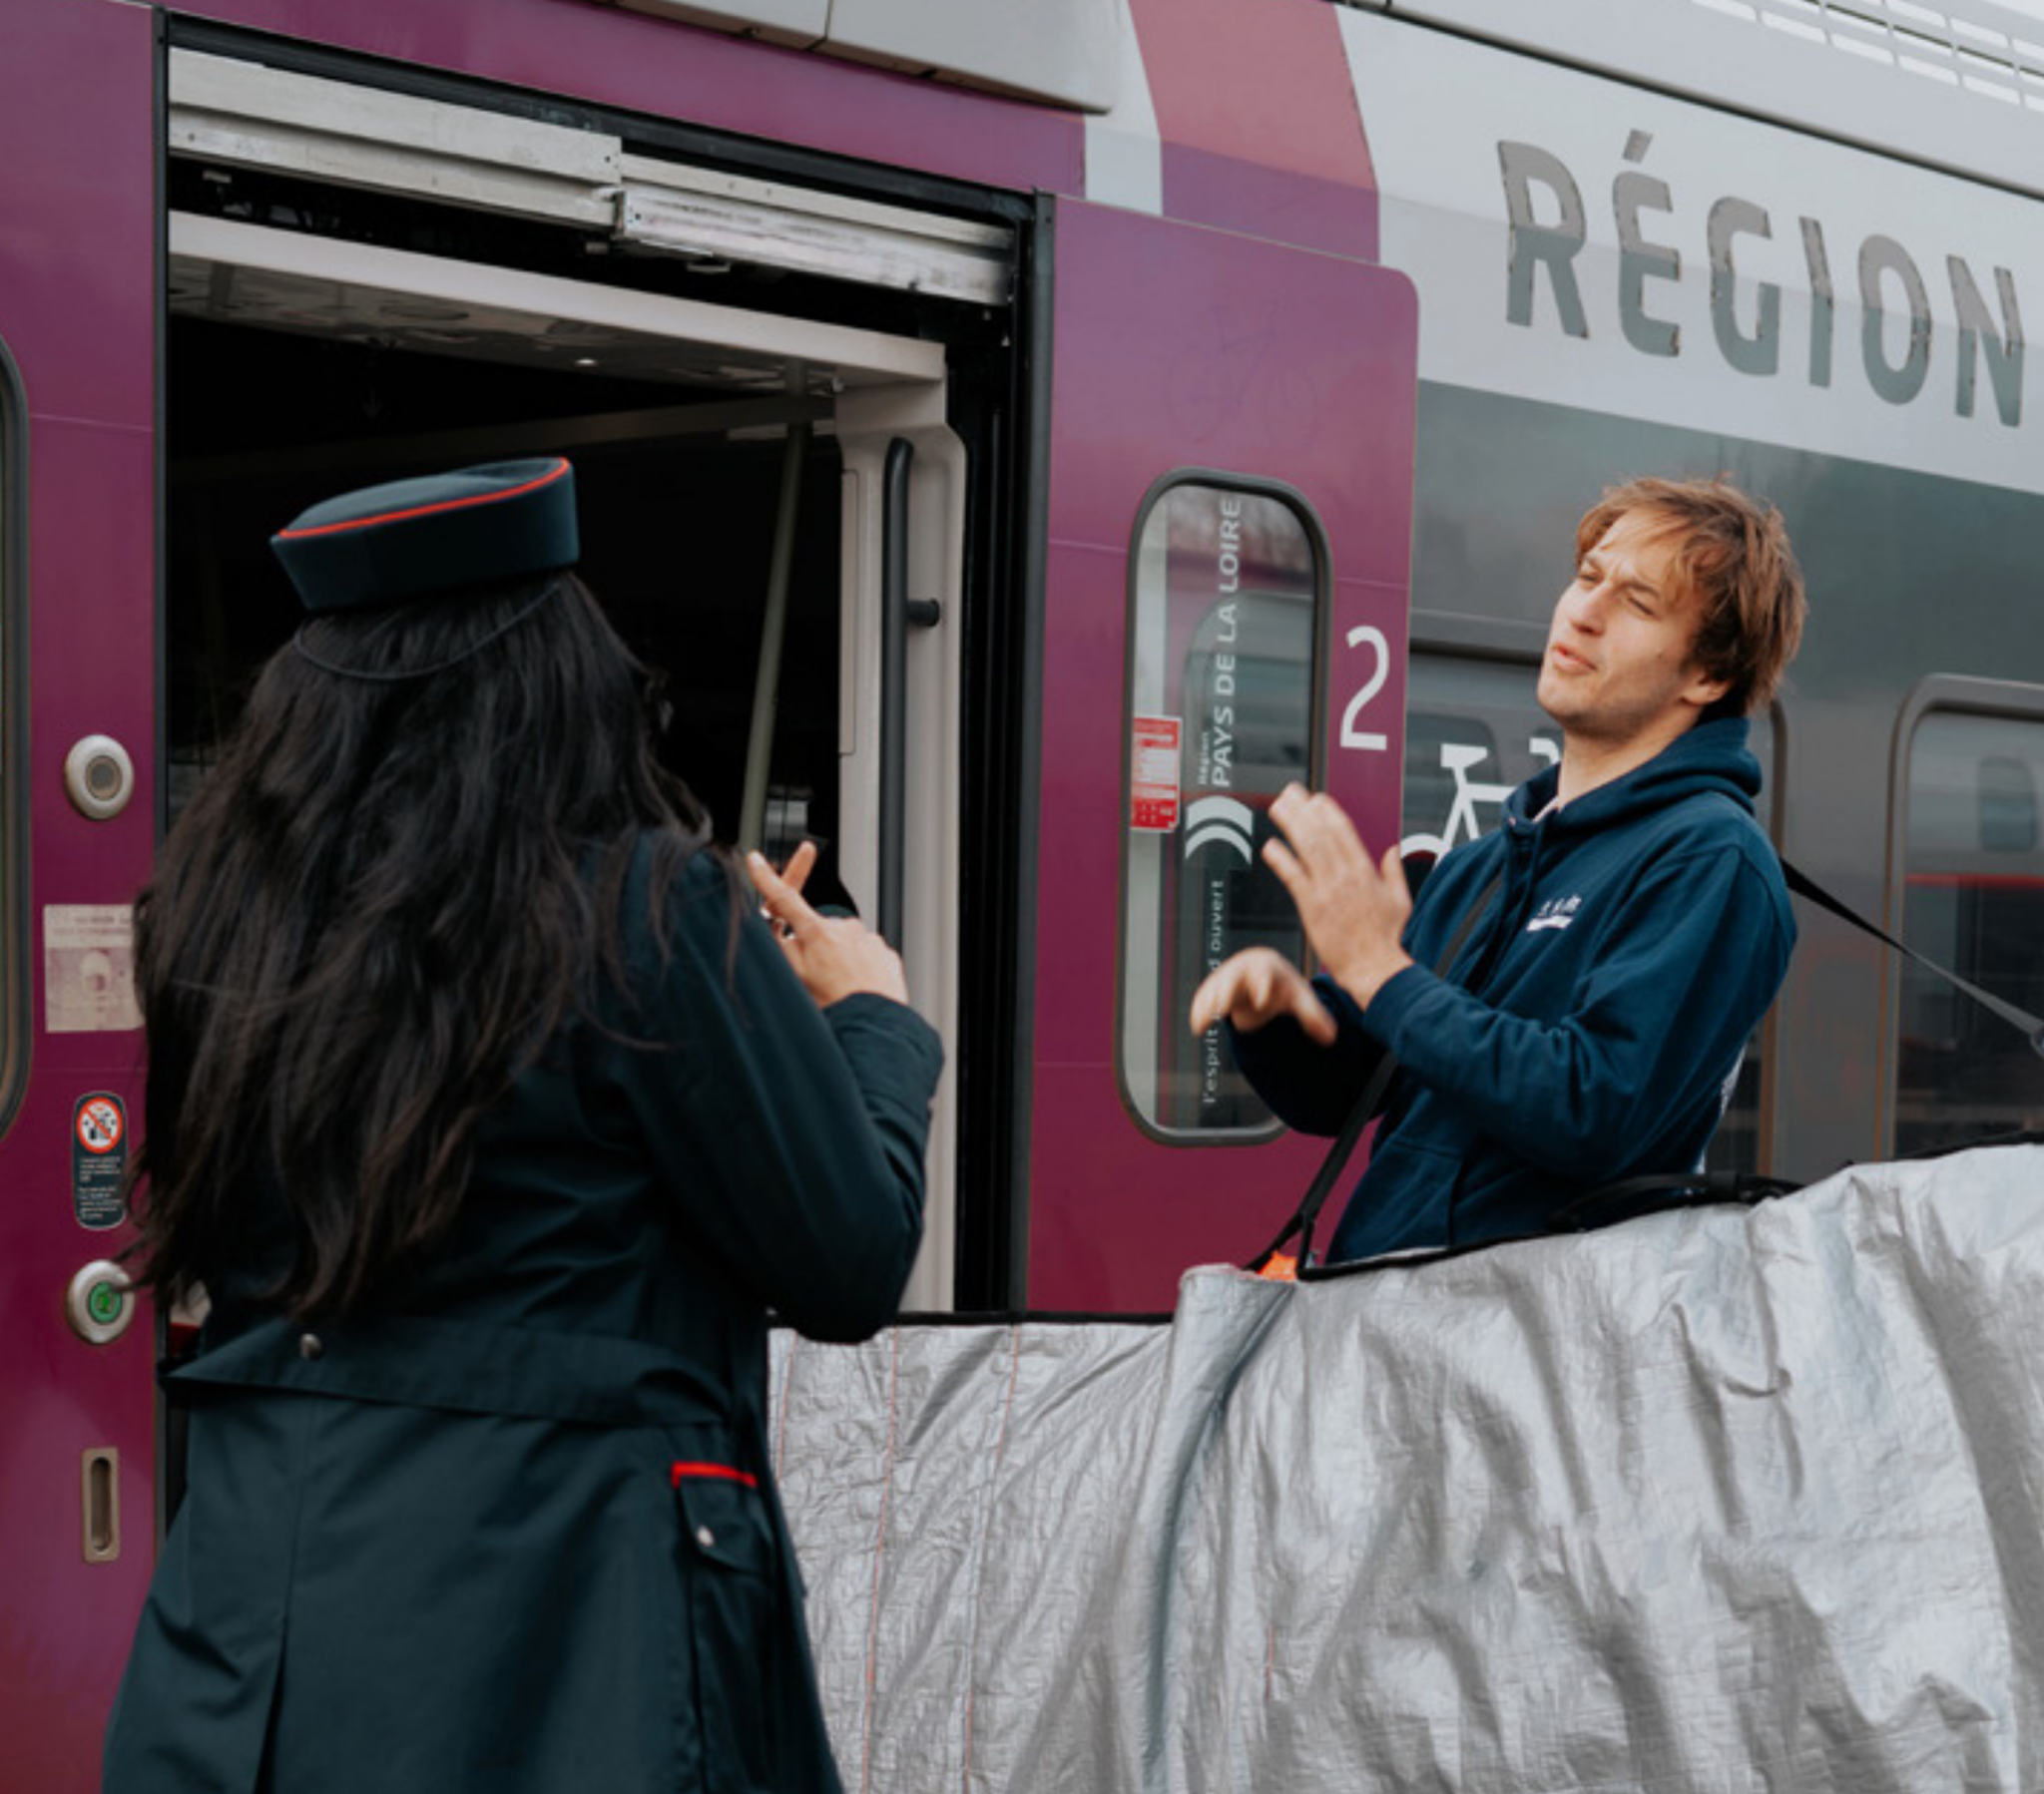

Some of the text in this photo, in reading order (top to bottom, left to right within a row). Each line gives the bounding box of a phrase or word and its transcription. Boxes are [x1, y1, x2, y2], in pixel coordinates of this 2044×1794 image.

[1497, 129, 2025, 427] RÉGION
[1212, 499, 1241, 787] PAYS DE LA LOIRE
[1340, 625, 1389, 750] 2
[1211, 880, 1224, 951] ouvert
